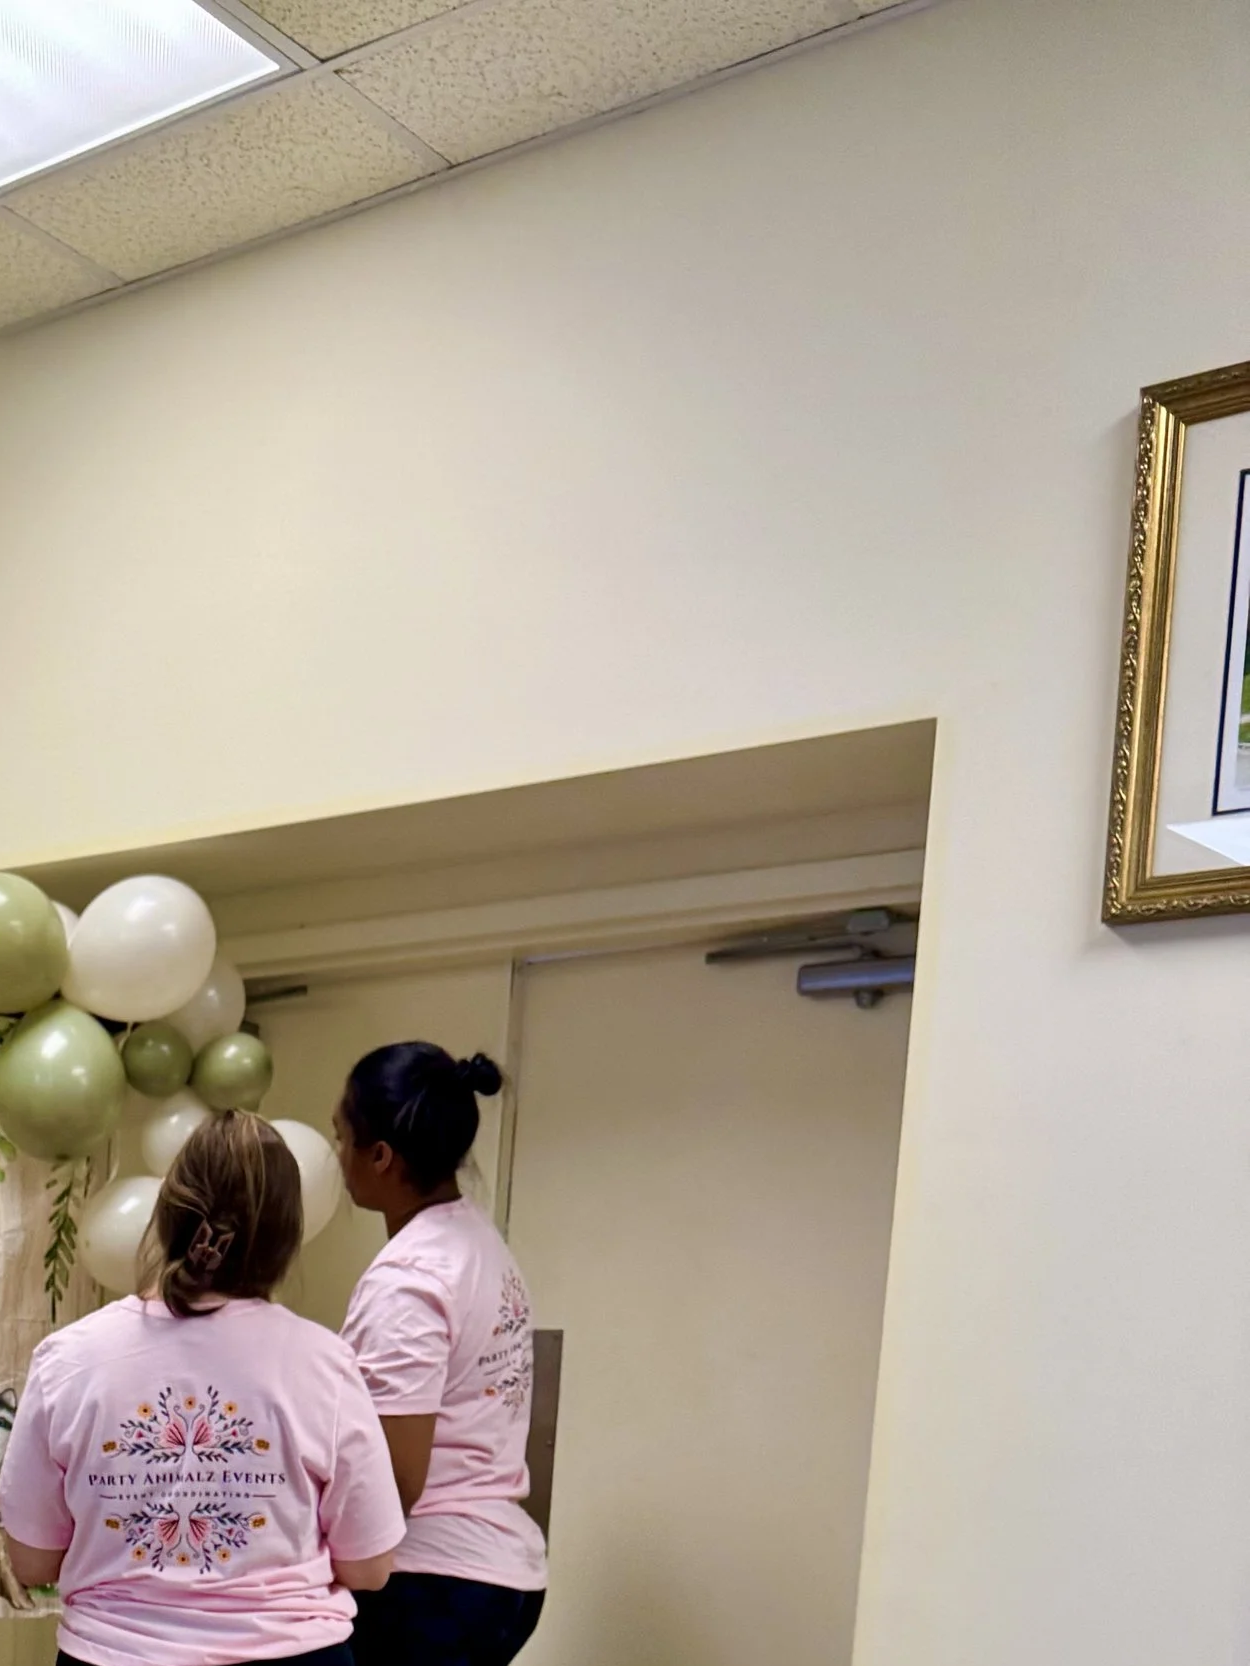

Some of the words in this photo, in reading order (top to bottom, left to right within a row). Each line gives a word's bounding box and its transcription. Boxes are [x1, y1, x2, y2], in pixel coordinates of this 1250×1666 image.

[88, 1474, 137, 1486] PARTY
[143, 1471, 215, 1484] ANIMALZ
[223, 1470, 286, 1485] EVENTS
